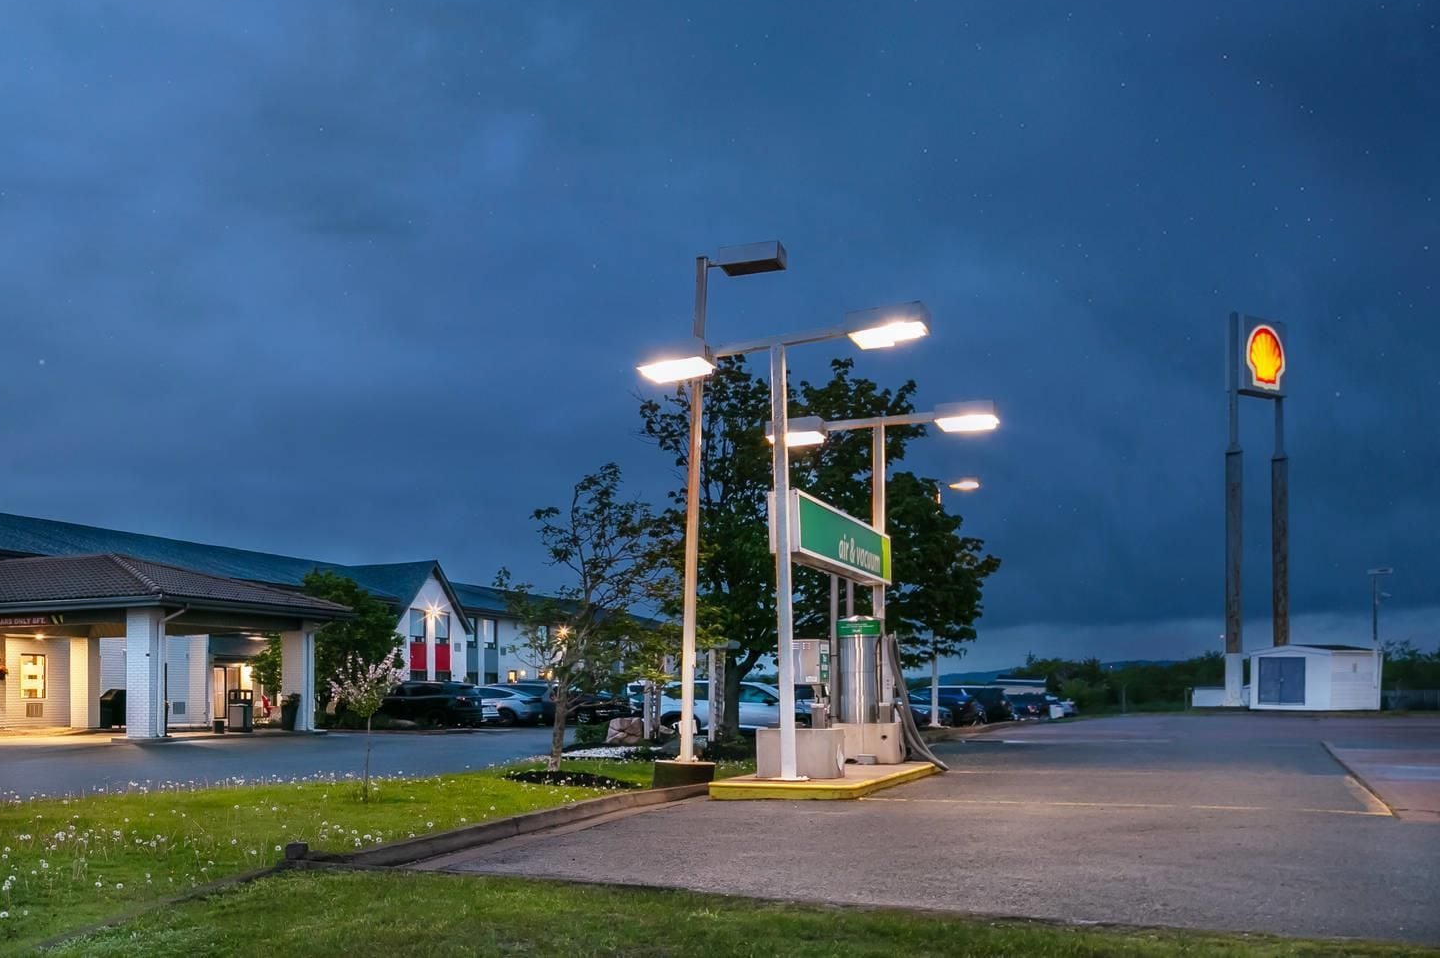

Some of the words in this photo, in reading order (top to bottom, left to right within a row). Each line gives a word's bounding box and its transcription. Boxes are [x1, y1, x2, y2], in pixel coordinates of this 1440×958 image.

[839, 532, 850, 562] air
[850, 537, 856, 564] &
[856, 546, 881, 573] vacuum
[14, 617, 32, 625] ONLY
